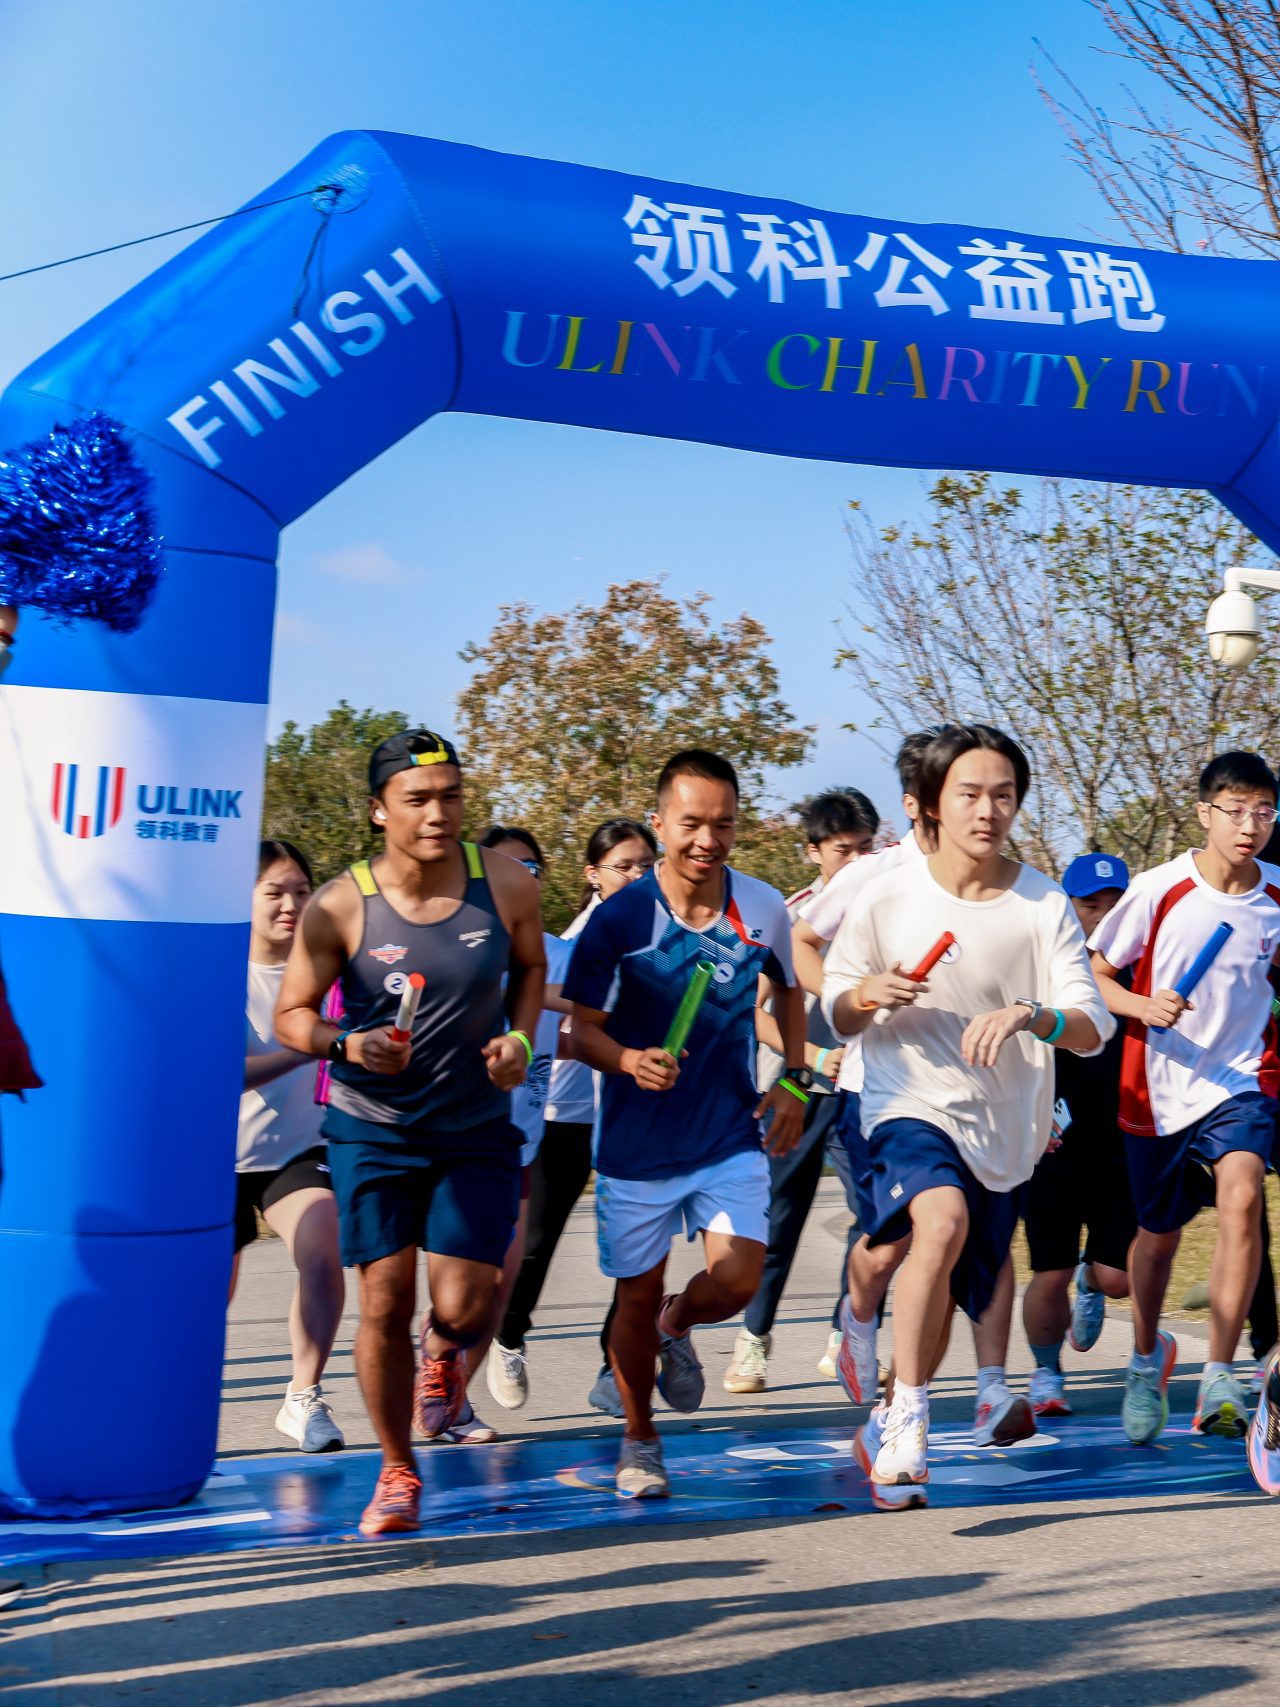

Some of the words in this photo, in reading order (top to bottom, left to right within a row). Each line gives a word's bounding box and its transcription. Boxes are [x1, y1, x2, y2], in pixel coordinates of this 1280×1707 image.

[623, 194, 1167, 333] 领科公益跑
[166, 247, 443, 468] FINISH
[502, 310, 752, 385] ULINK
[765, 333, 1113, 410] CHARITY
[1120, 359, 1267, 418] RUN
[135, 819, 220, 843] 领科教育
[137, 784, 243, 818] ULINK
